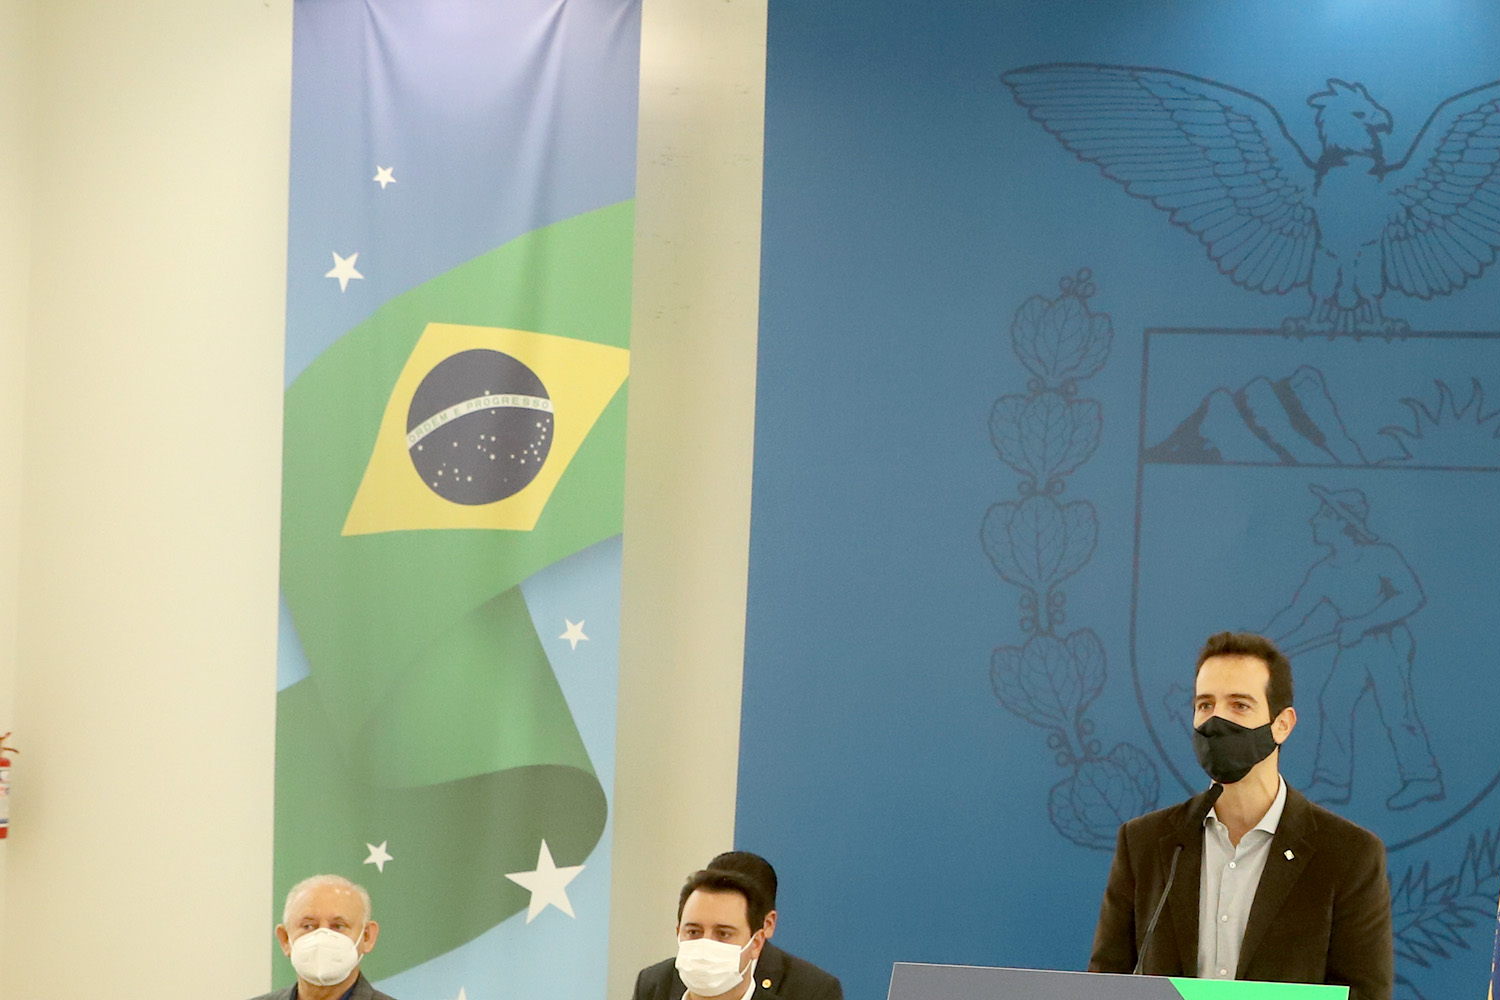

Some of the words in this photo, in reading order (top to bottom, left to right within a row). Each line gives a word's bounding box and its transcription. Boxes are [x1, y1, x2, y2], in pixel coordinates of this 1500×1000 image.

[408, 412, 448, 443] ORDEM
[454, 407, 461, 416] E
[466, 396, 549, 410] PROGRESSO
